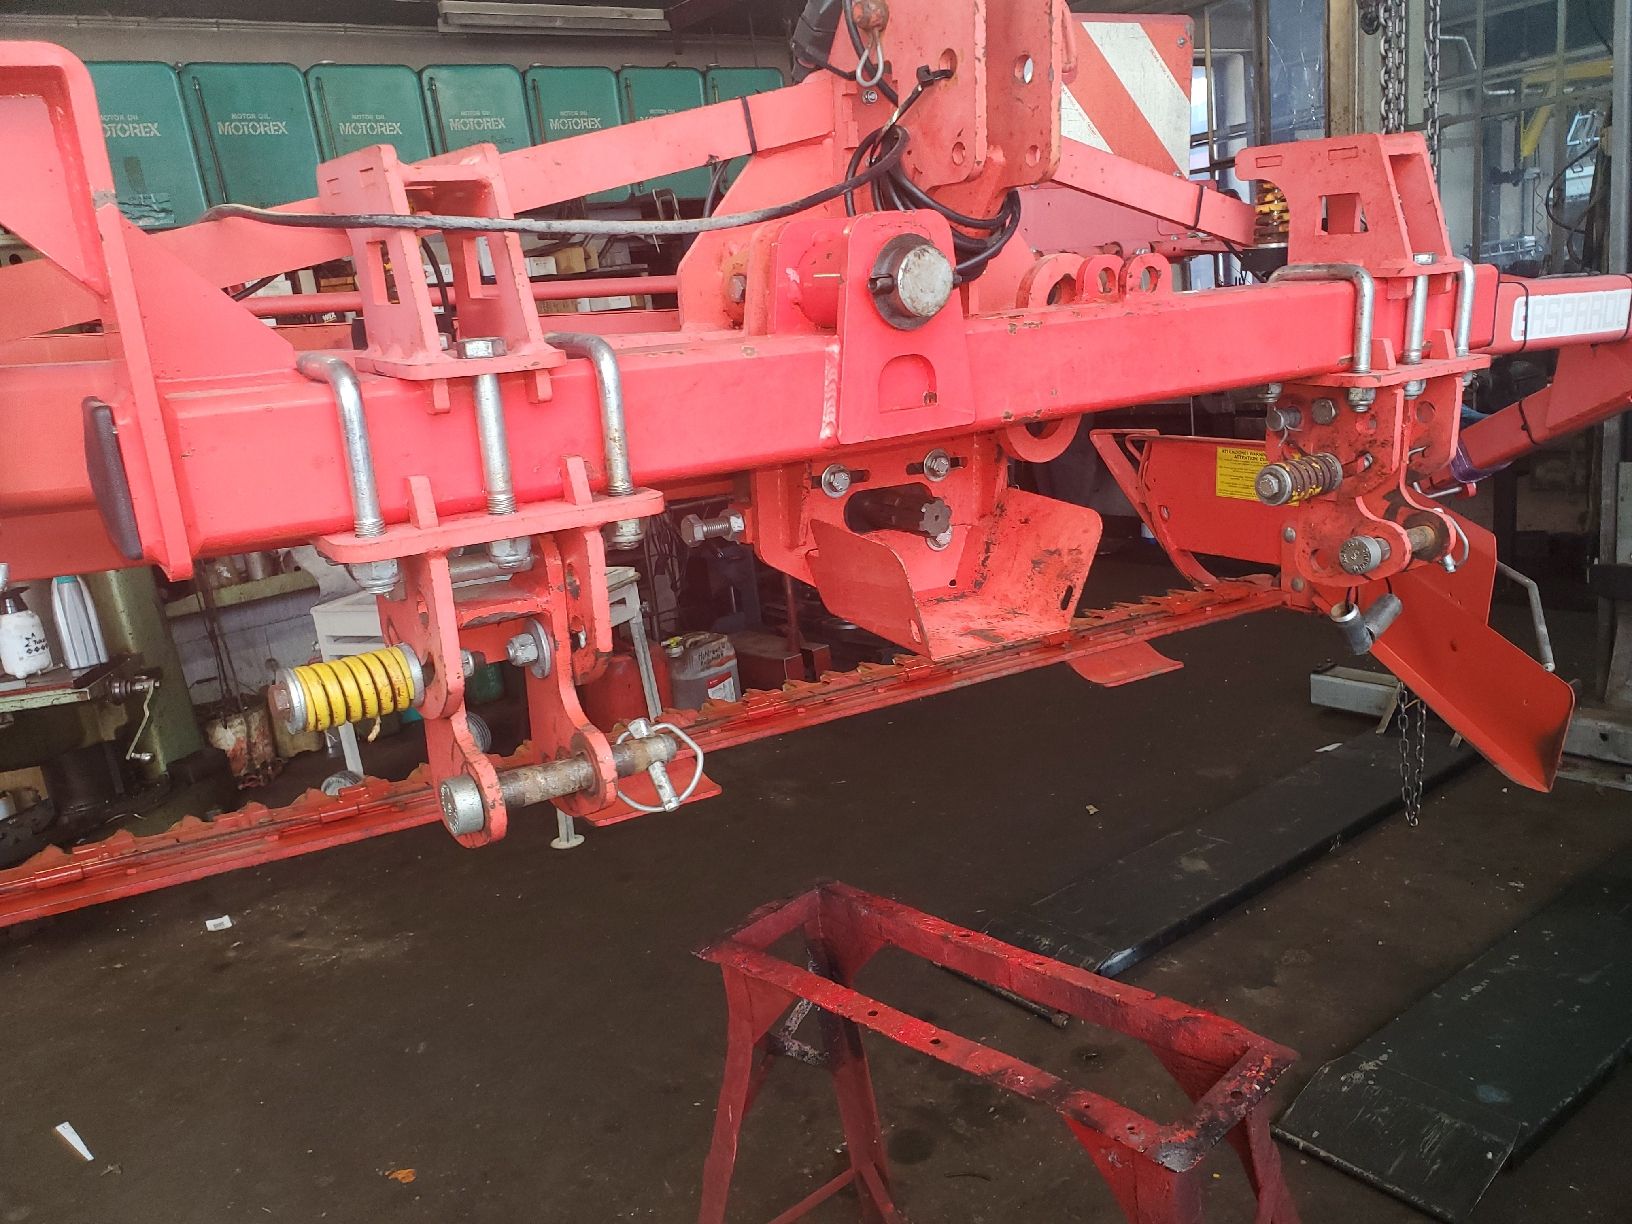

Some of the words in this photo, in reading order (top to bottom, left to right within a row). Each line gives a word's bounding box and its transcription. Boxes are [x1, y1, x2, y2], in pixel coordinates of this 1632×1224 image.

[231, 112, 256, 120] MOTOR
[102, 122, 162, 138] OTOREX
[217, 120, 288, 135] MOTOREX
[338, 121, 403, 135] MOTOREX
[448, 117, 507, 131] MOTOREX
[548, 117, 602, 130] MOTOREX
